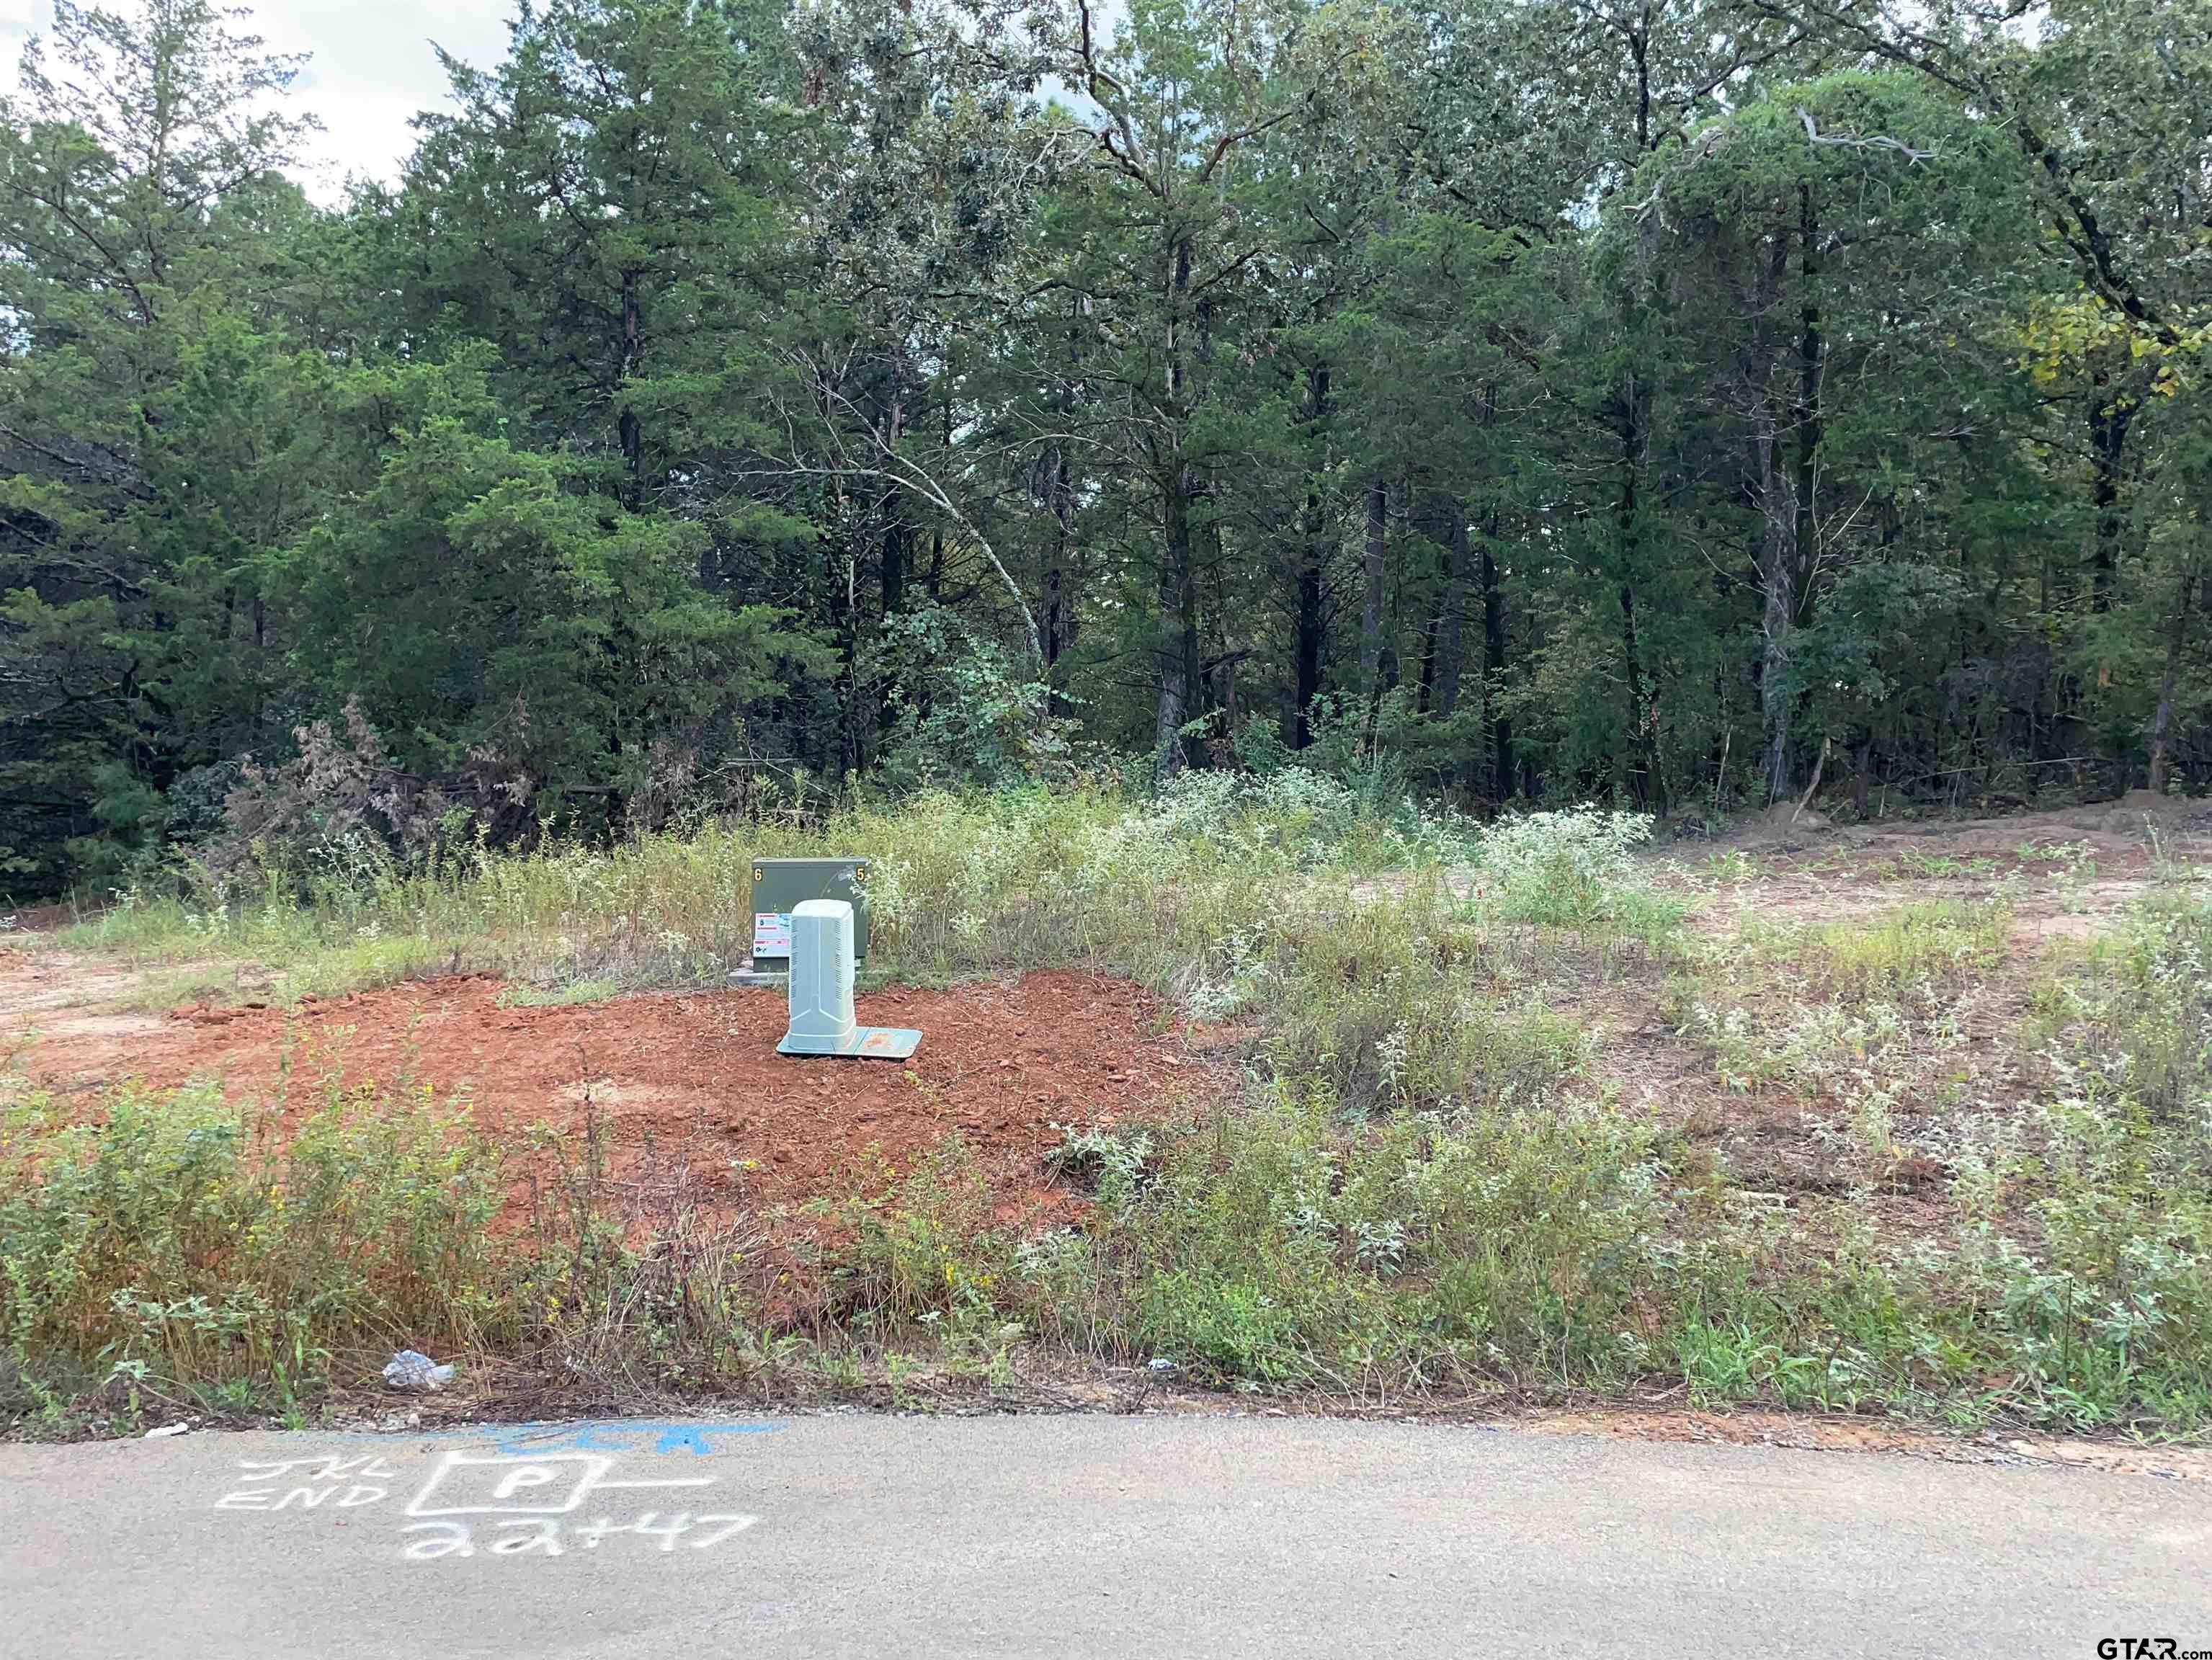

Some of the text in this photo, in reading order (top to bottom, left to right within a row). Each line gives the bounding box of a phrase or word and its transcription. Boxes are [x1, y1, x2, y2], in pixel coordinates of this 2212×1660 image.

[754, 867, 762, 881] 6
[856, 867, 865, 881] 5
[493, 1465, 558, 1499] P
[215, 1485, 388, 1511] END
